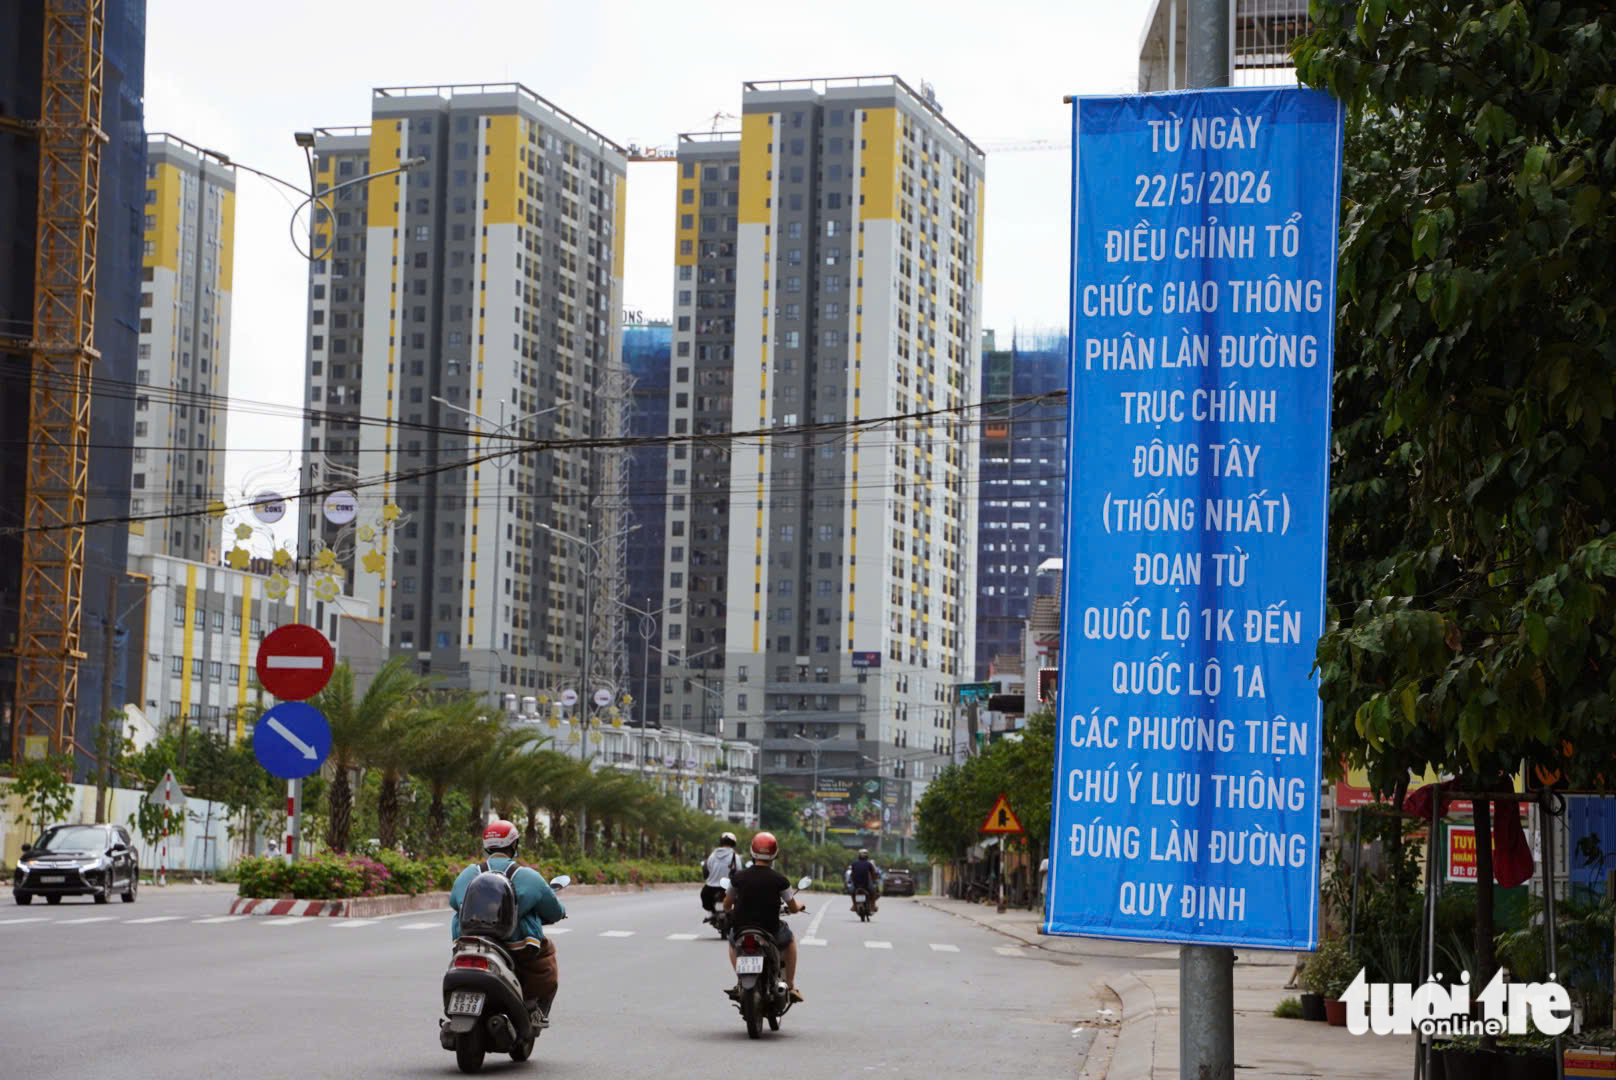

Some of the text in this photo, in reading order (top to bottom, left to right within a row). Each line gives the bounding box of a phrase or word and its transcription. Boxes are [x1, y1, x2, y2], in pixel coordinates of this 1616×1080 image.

[1148, 109, 1261, 152] TỪ NGÀY
[1136, 171, 1270, 206] 22/5/2026
[1105, 212, 1301, 262] ĐIỀU CHỈNH TỔ
[1084, 274, 1322, 316] CHỨC GIAO THÔNG
[1086, 327, 1316, 370] PHÂN LÀN ĐƯỜNG
[1121, 382, 1275, 429] TRỤC CHÍNH
[1133, 437, 1260, 477] ĐÔNG TÂY
[1103, 488, 1289, 534] (THỐNG NHẤT)
[1133, 546, 1249, 592] ĐOẠN TỪ
[1084, 597, 1300, 647] QUỐC LỘ 1K ĐẾN
[1113, 652, 1264, 702] QUỐC LỘ 1A
[1071, 707, 1307, 761] CÁC PHƯƠNG TIỆN
[1069, 762, 1304, 811] CHÚ Ý LƯU THÔNG
[1069, 817, 1305, 867] ĐÚNG LÀN ĐƯỜNG
[1120, 882, 1245, 926] QUY ĐỊNH
